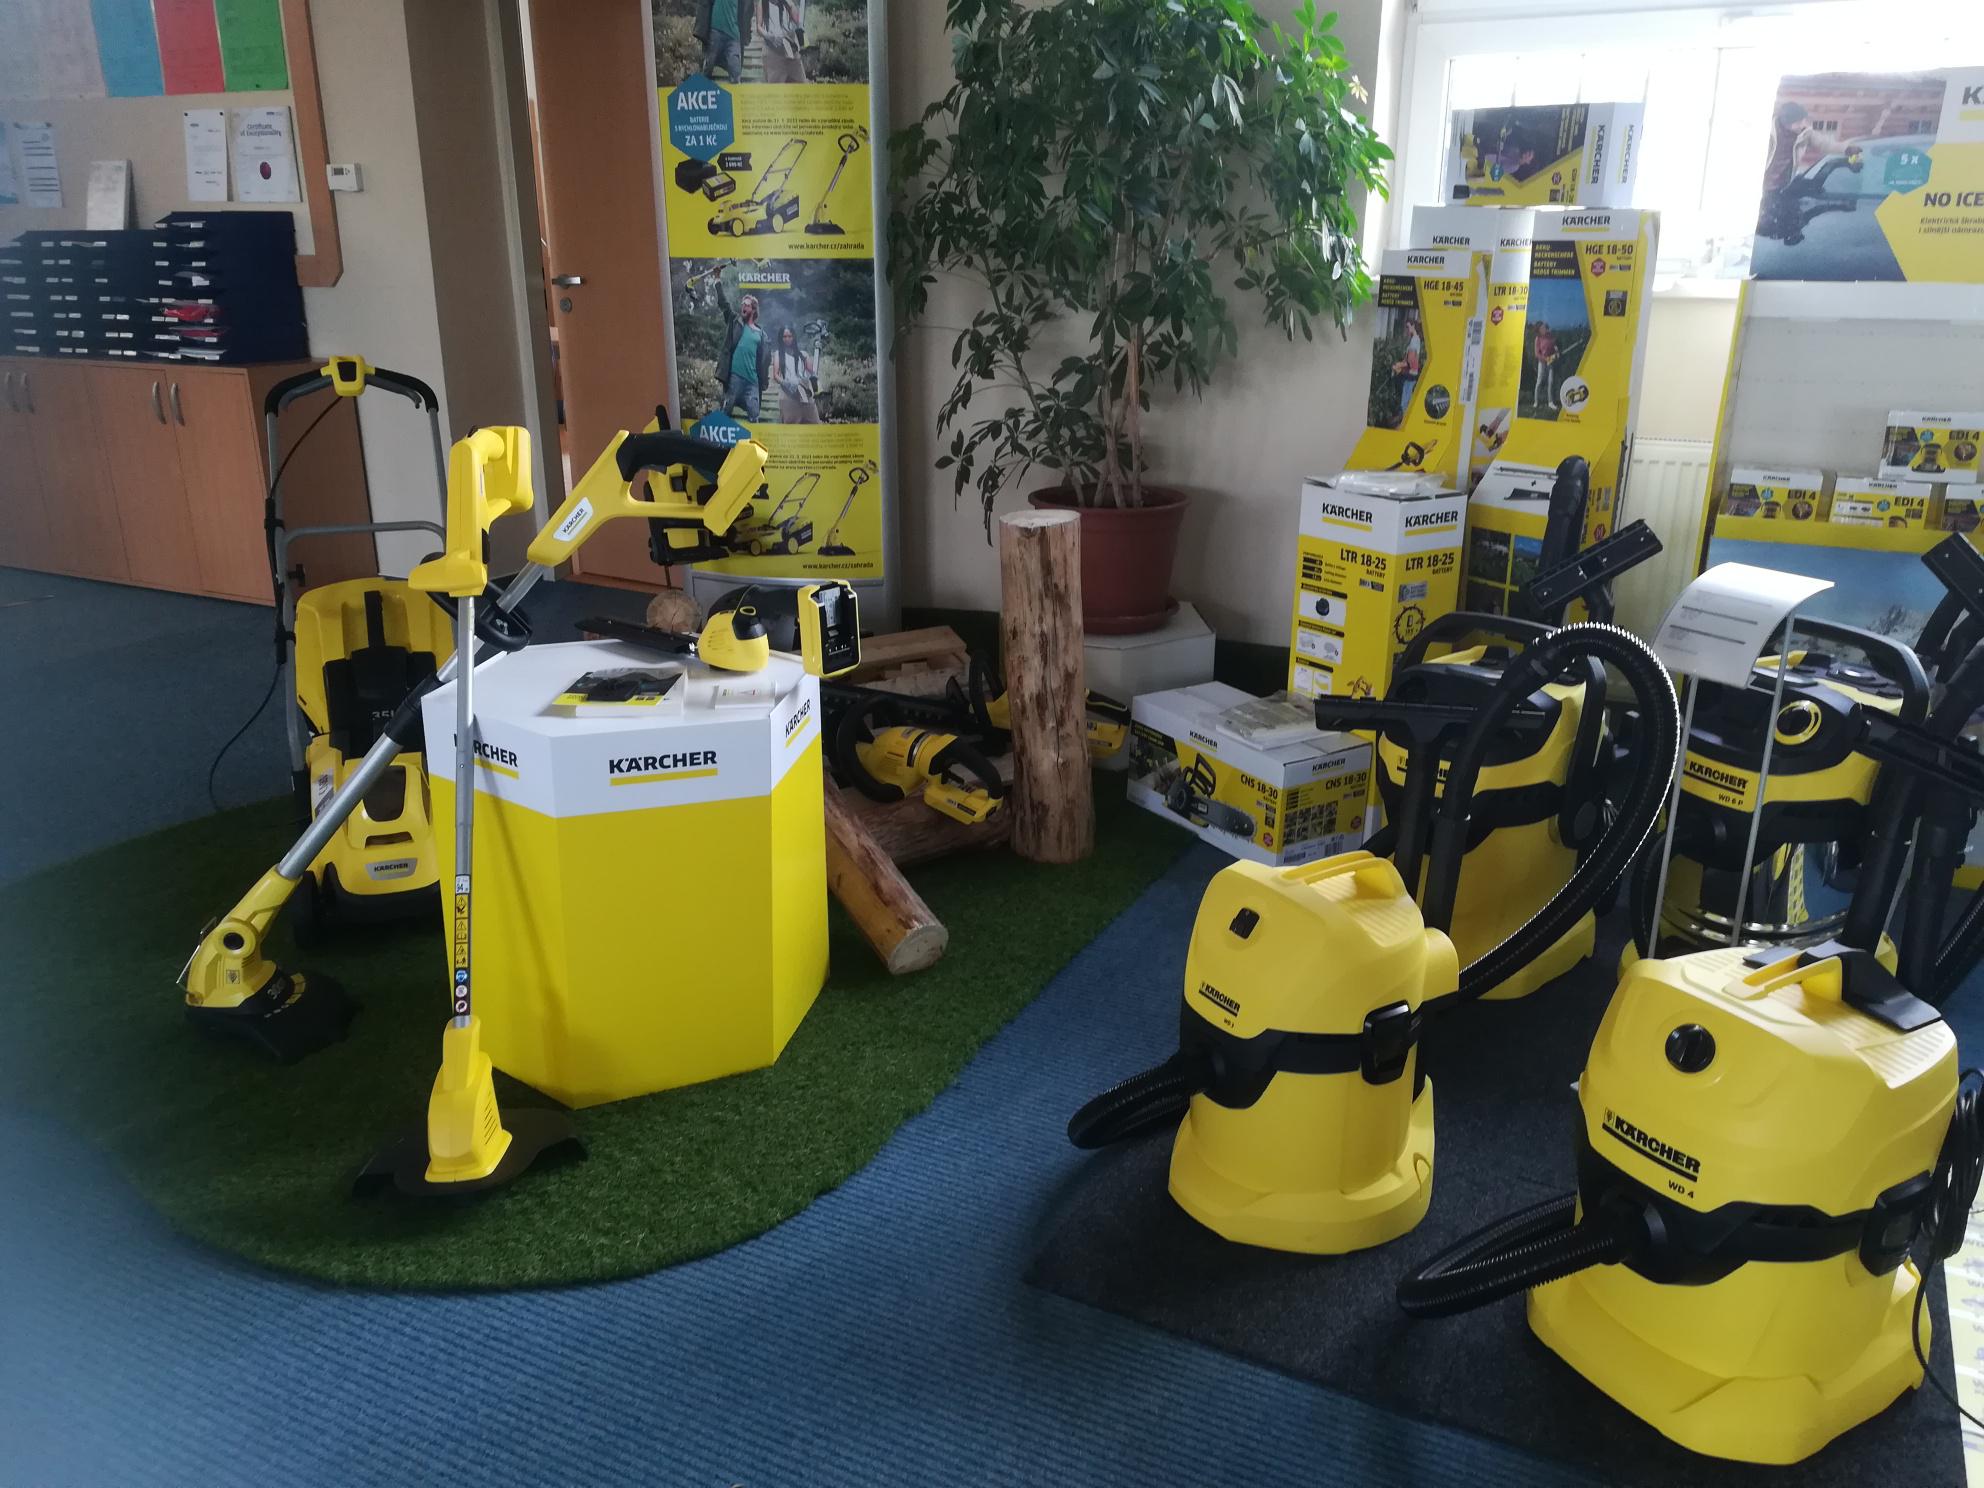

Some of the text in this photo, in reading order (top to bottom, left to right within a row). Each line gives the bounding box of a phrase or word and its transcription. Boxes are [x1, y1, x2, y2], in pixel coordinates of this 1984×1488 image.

[685, 135, 697, 147] ZA
[699, 135, 704, 146] 1
[1924, 191, 1984, 207] NO ICE
[1585, 244, 1633, 255] HGE 18-50
[1423, 280, 1464, 292] HGE 18-45
[1494, 285, 1506, 296] LTR
[1949, 429, 1980, 442] EDI 4
[1787, 489, 1816, 501] EDI 4
[1894, 496, 1924, 508] EDI 4
[1322, 502, 1373, 524] KÄRCHER
[1405, 510, 1458, 528] KÄRCHER
[1340, 548, 1358, 564] LTR
[1361, 553, 1387, 571] 18-25
[1406, 552, 1455, 572] LTR 18-25
[1366, 568, 1386, 579] BATTERY
[453, 733, 519, 768] RCHER
[609, 750, 717, 775] KÄRCHER
[1240, 773, 1255, 789] CNS
[1257, 781, 1278, 800] 18-30
[1325, 772, 1367, 790] CNS 18-30
[1614, 1114, 1701, 1174] KÄRCHER
[1668, 1179, 1694, 1199] WD 4
